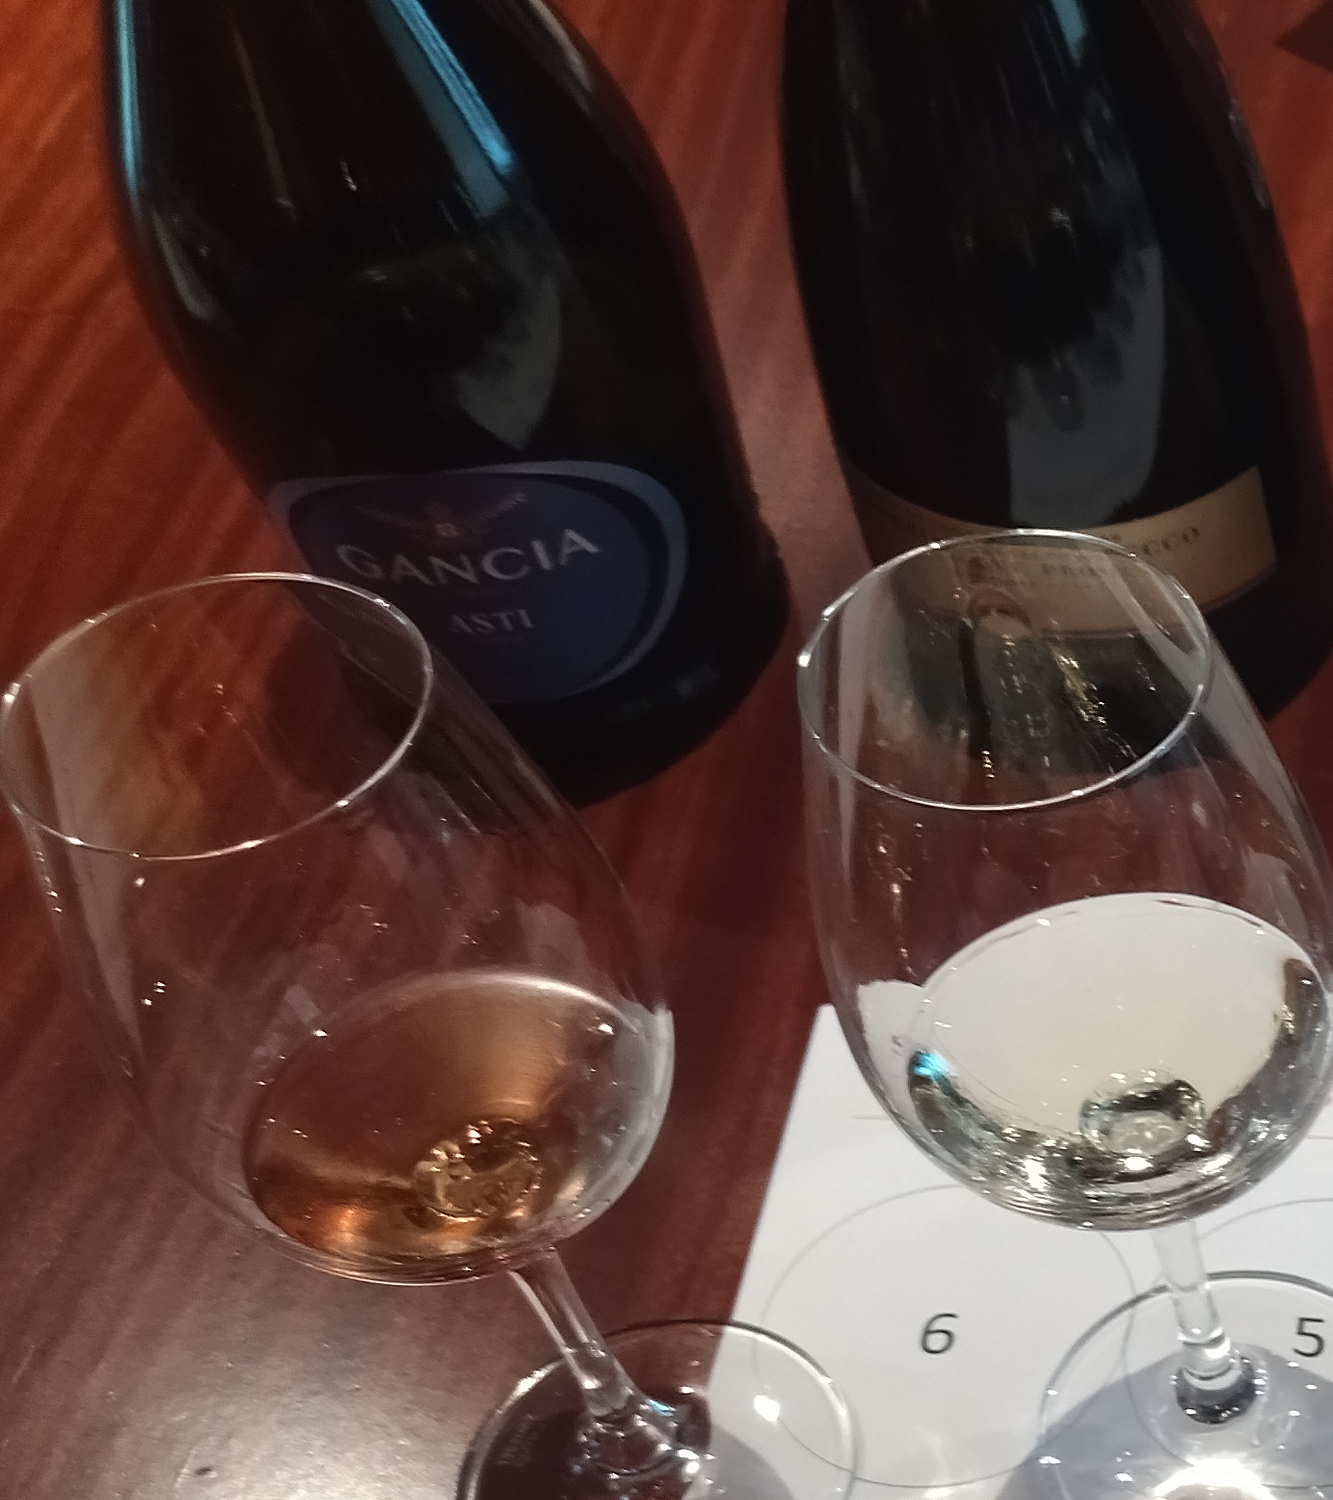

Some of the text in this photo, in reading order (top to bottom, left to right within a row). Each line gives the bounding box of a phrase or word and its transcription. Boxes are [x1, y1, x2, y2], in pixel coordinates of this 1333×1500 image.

[336, 528, 600, 587] GANCIA
[451, 608, 534, 635] ASTI
[919, 1313, 959, 1354] 6
[1292, 1317, 1326, 1358] 5
